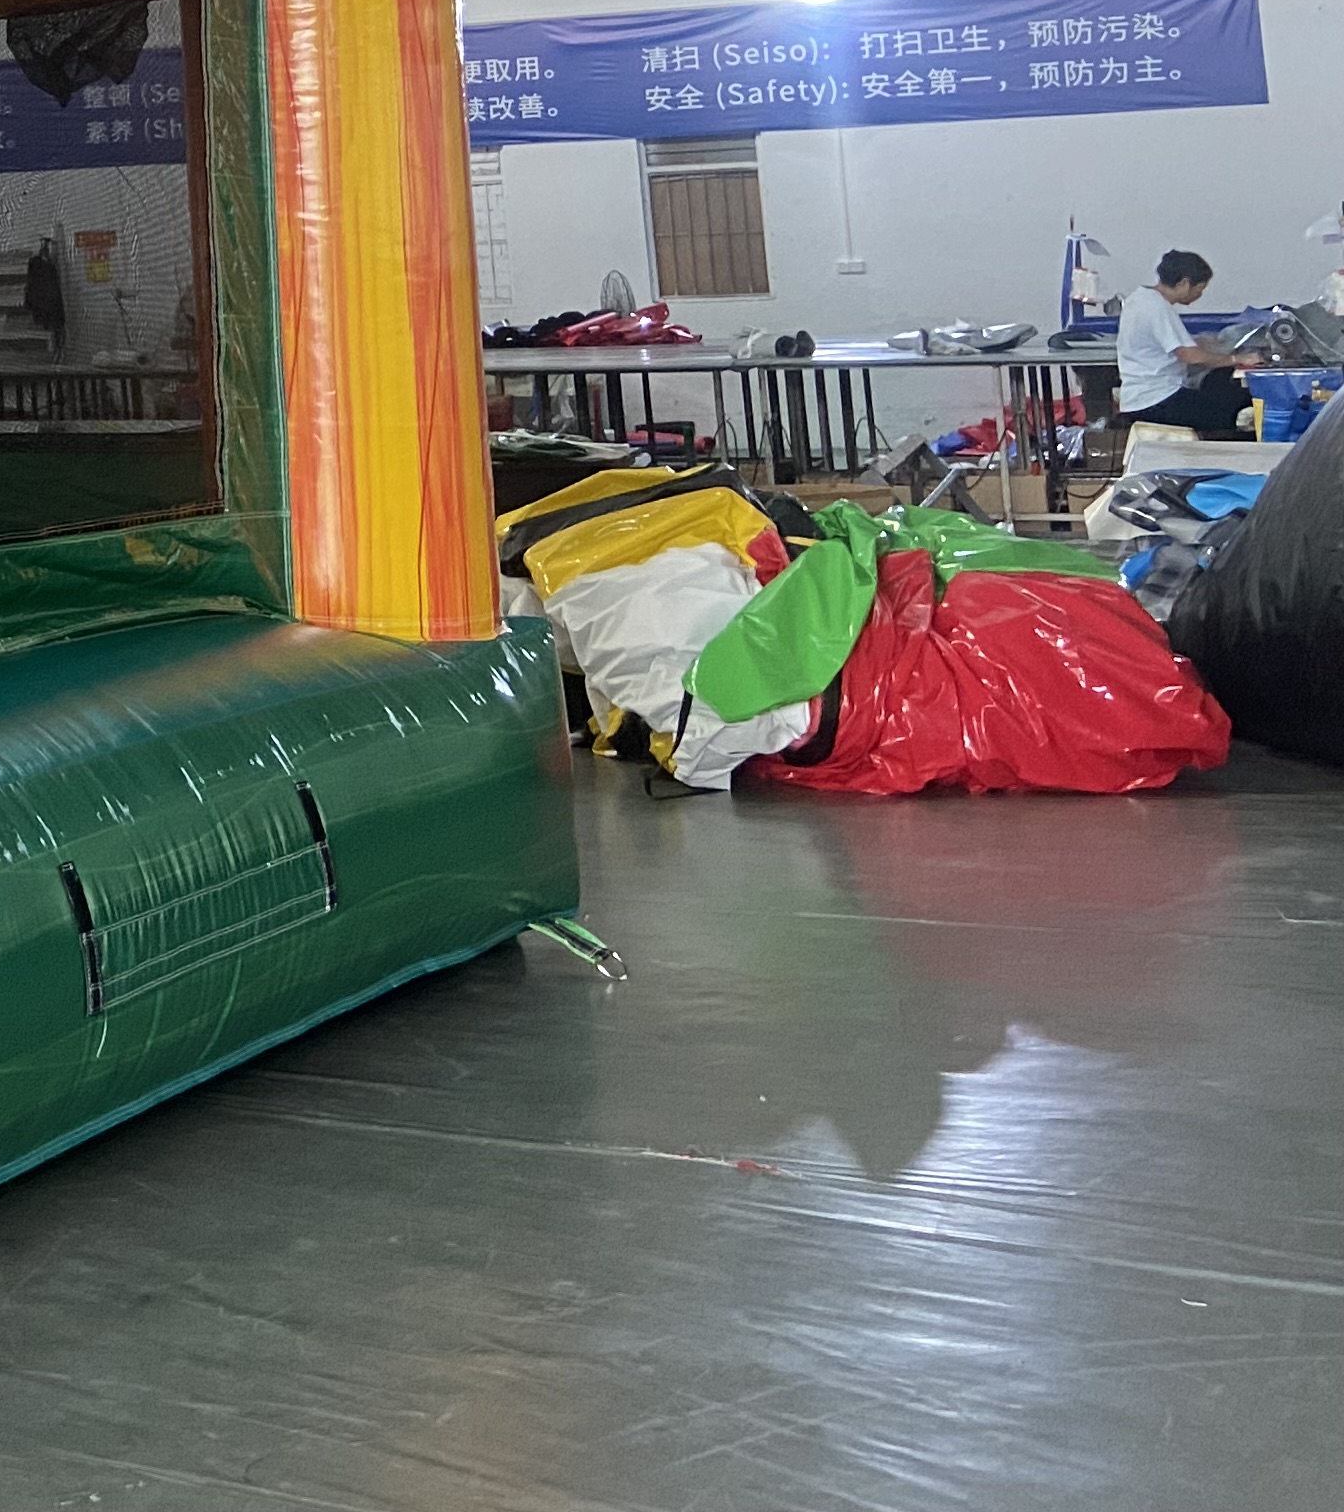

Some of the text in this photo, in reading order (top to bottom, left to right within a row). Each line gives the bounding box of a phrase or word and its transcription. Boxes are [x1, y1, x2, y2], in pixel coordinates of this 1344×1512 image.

[640, 11, 1186, 73] 清扫 (Seiso): 打扫卫生，预防污染。
[644, 54, 1183, 112] 安全 (Safety): 安全第一，预防为主。
